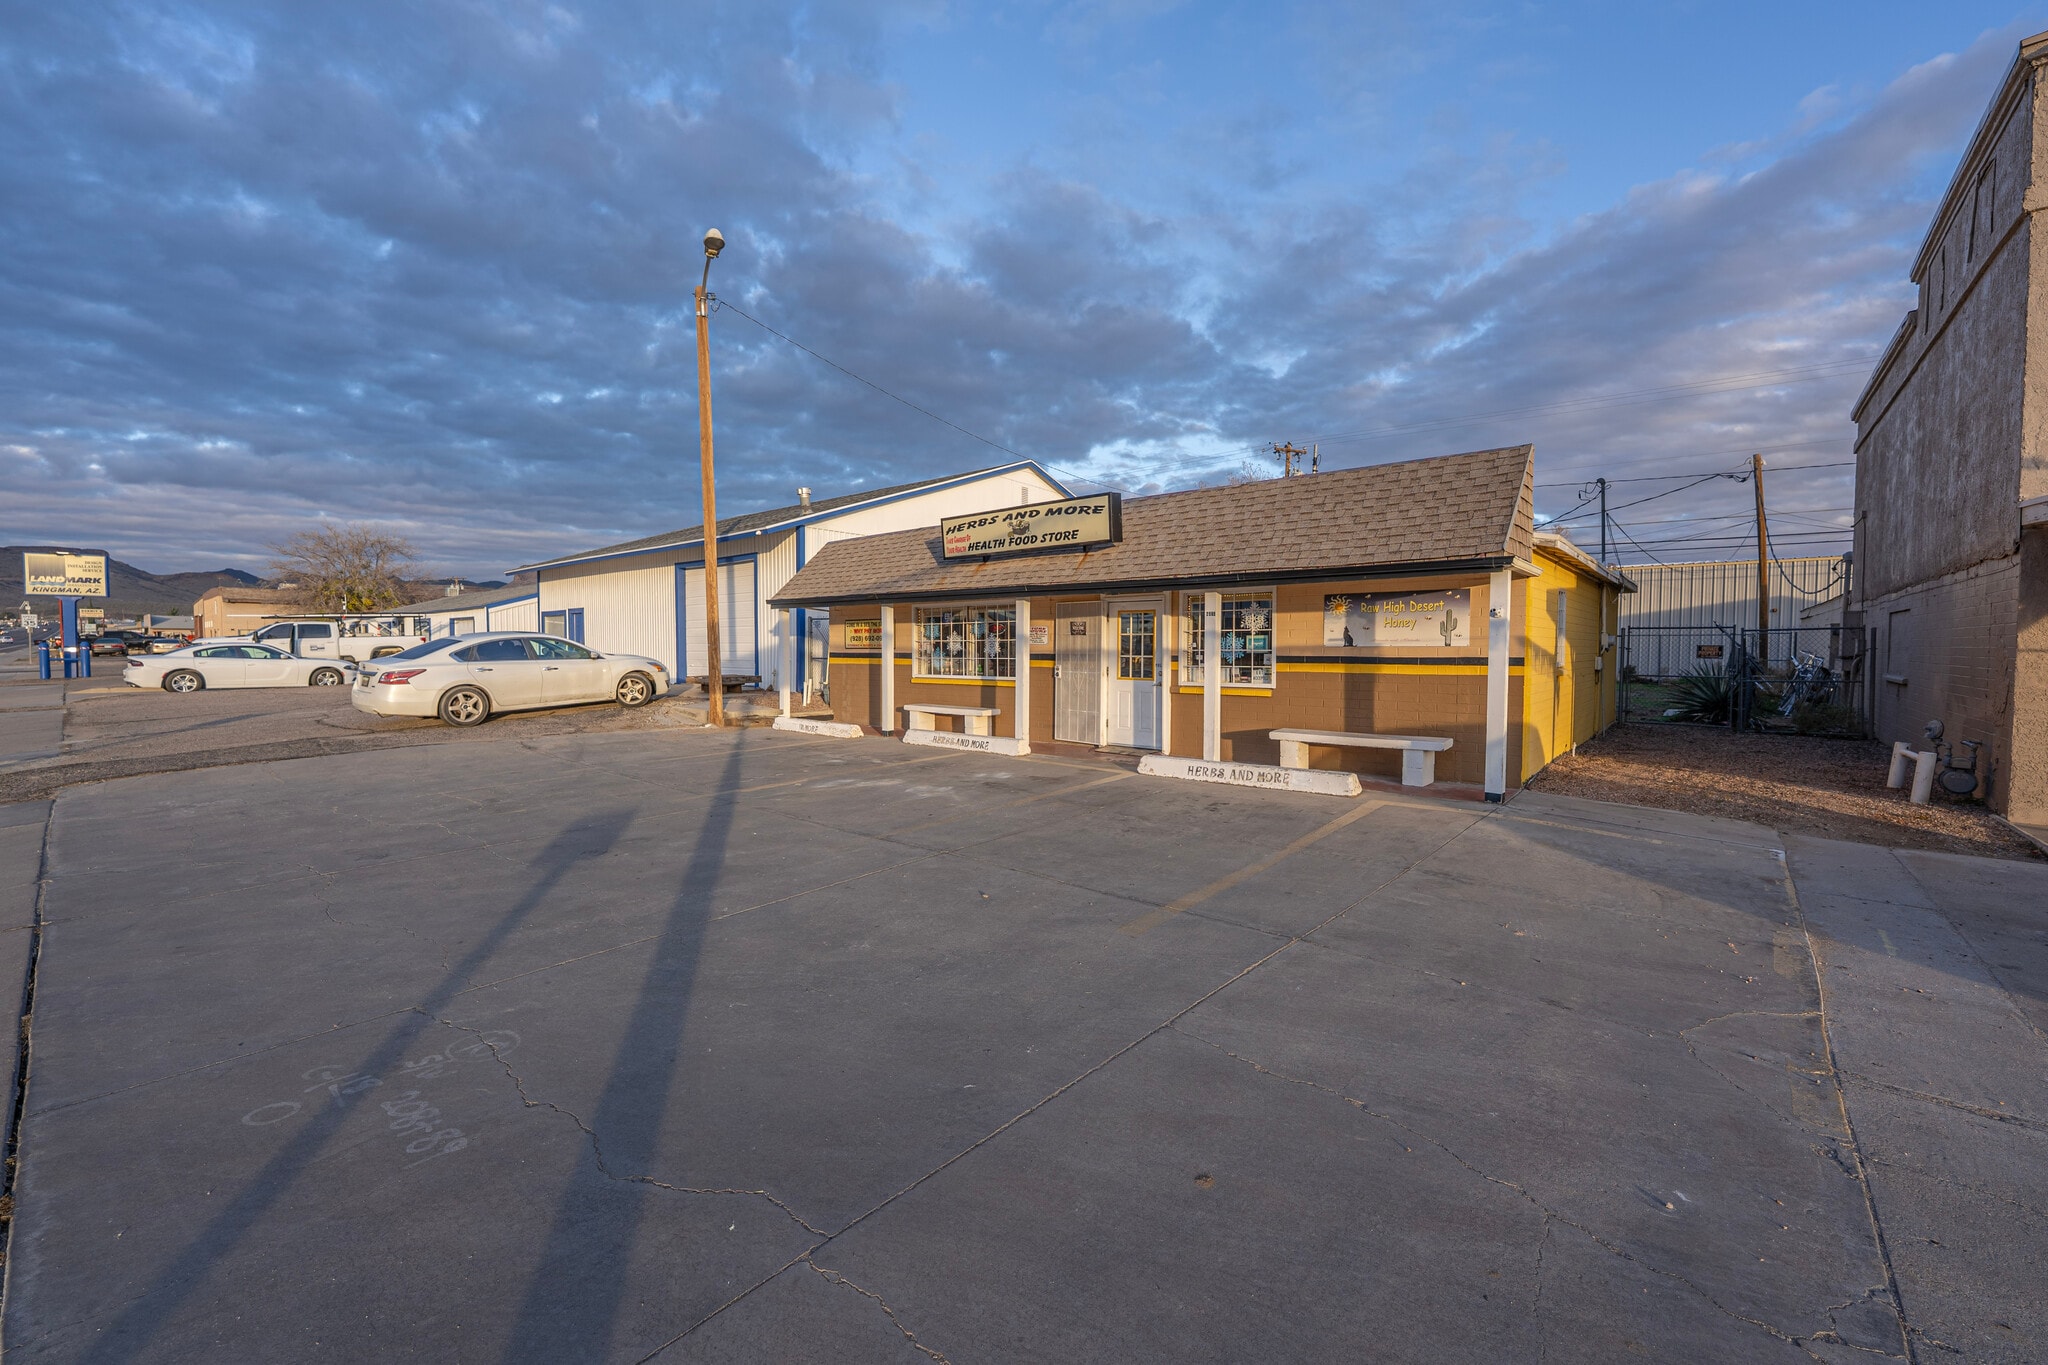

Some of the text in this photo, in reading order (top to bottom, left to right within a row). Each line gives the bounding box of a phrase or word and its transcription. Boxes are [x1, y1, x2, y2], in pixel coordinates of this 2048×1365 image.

[946, 505, 1106, 535] HERBS AND MORE
[967, 529, 1080, 551] HEALTH FOOD STORE
[30, 575, 102, 584] LANDMARK
[32, 586, 82, 594] KINGMAN,
[1360, 600, 1445, 616] Raw High Desert
[1383, 617, 1418, 631] Honey
[957, 738, 970, 747] AND
[971, 740, 990, 751] MORE
[1229, 769, 1254, 781] AND
[1257, 771, 1291, 786] MORE
